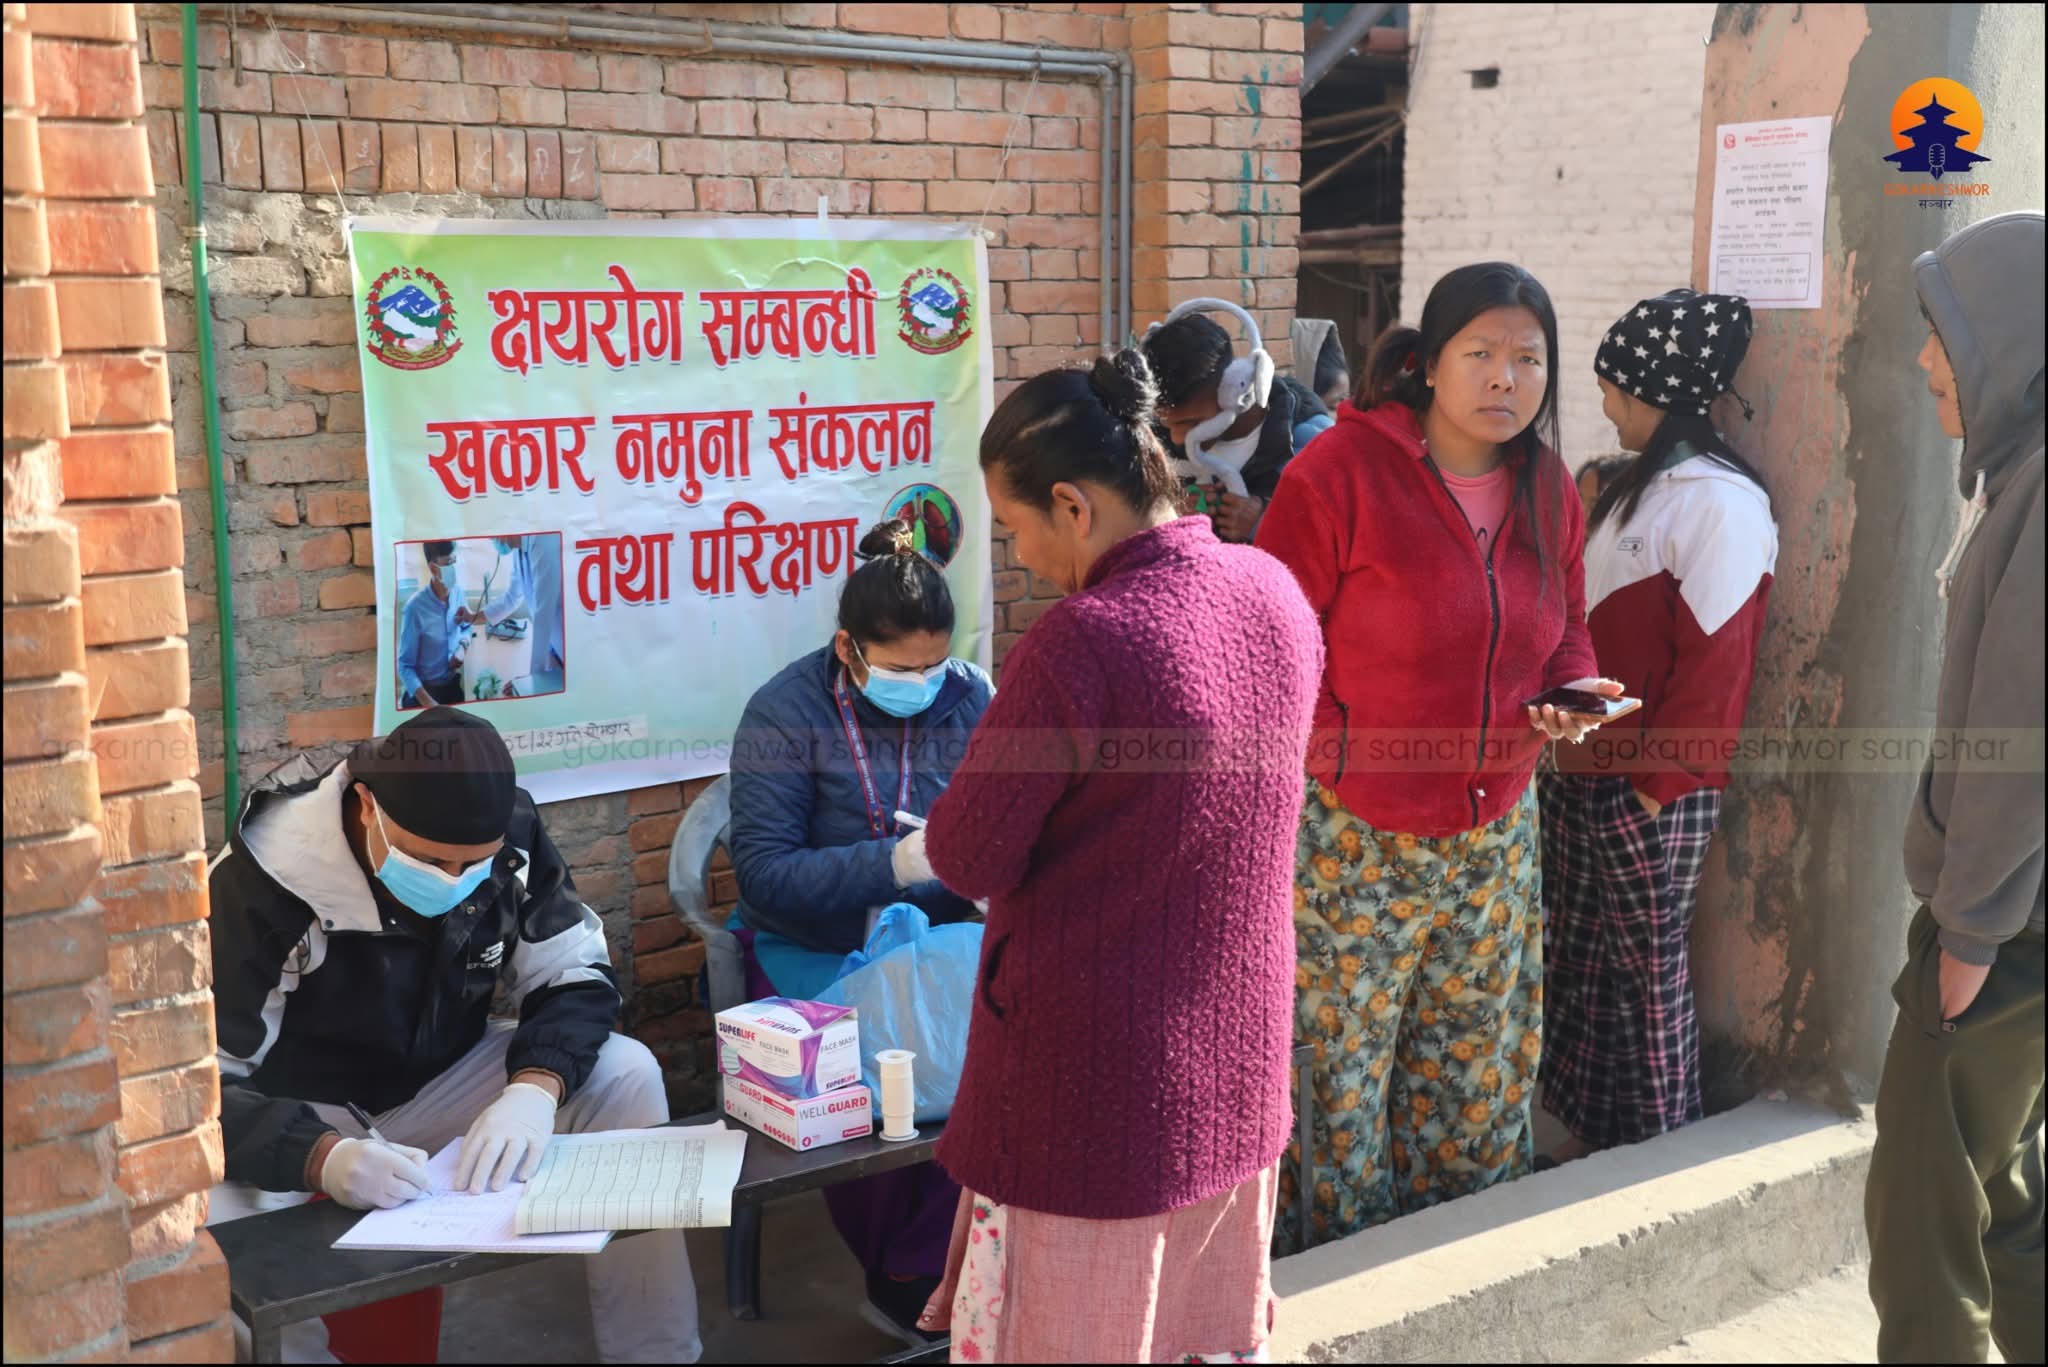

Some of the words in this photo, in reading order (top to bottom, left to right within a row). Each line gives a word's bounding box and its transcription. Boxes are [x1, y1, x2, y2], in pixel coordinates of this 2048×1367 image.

[487, 264, 683, 375] क्षयरोग
[700, 267, 878, 368] सम्बन्धी
[427, 415, 595, 501] खकार
[612, 410, 753, 503] नमुना
[768, 391, 935, 480] संकलन
[576, 532, 673, 613] तथा
[690, 501, 858, 595] परिक्षण
[718, 1022, 756, 1042] SUPERLIFE
[820, 1041, 837, 1053] FACE
[825, 1074, 856, 1090] SUPERLIFE
